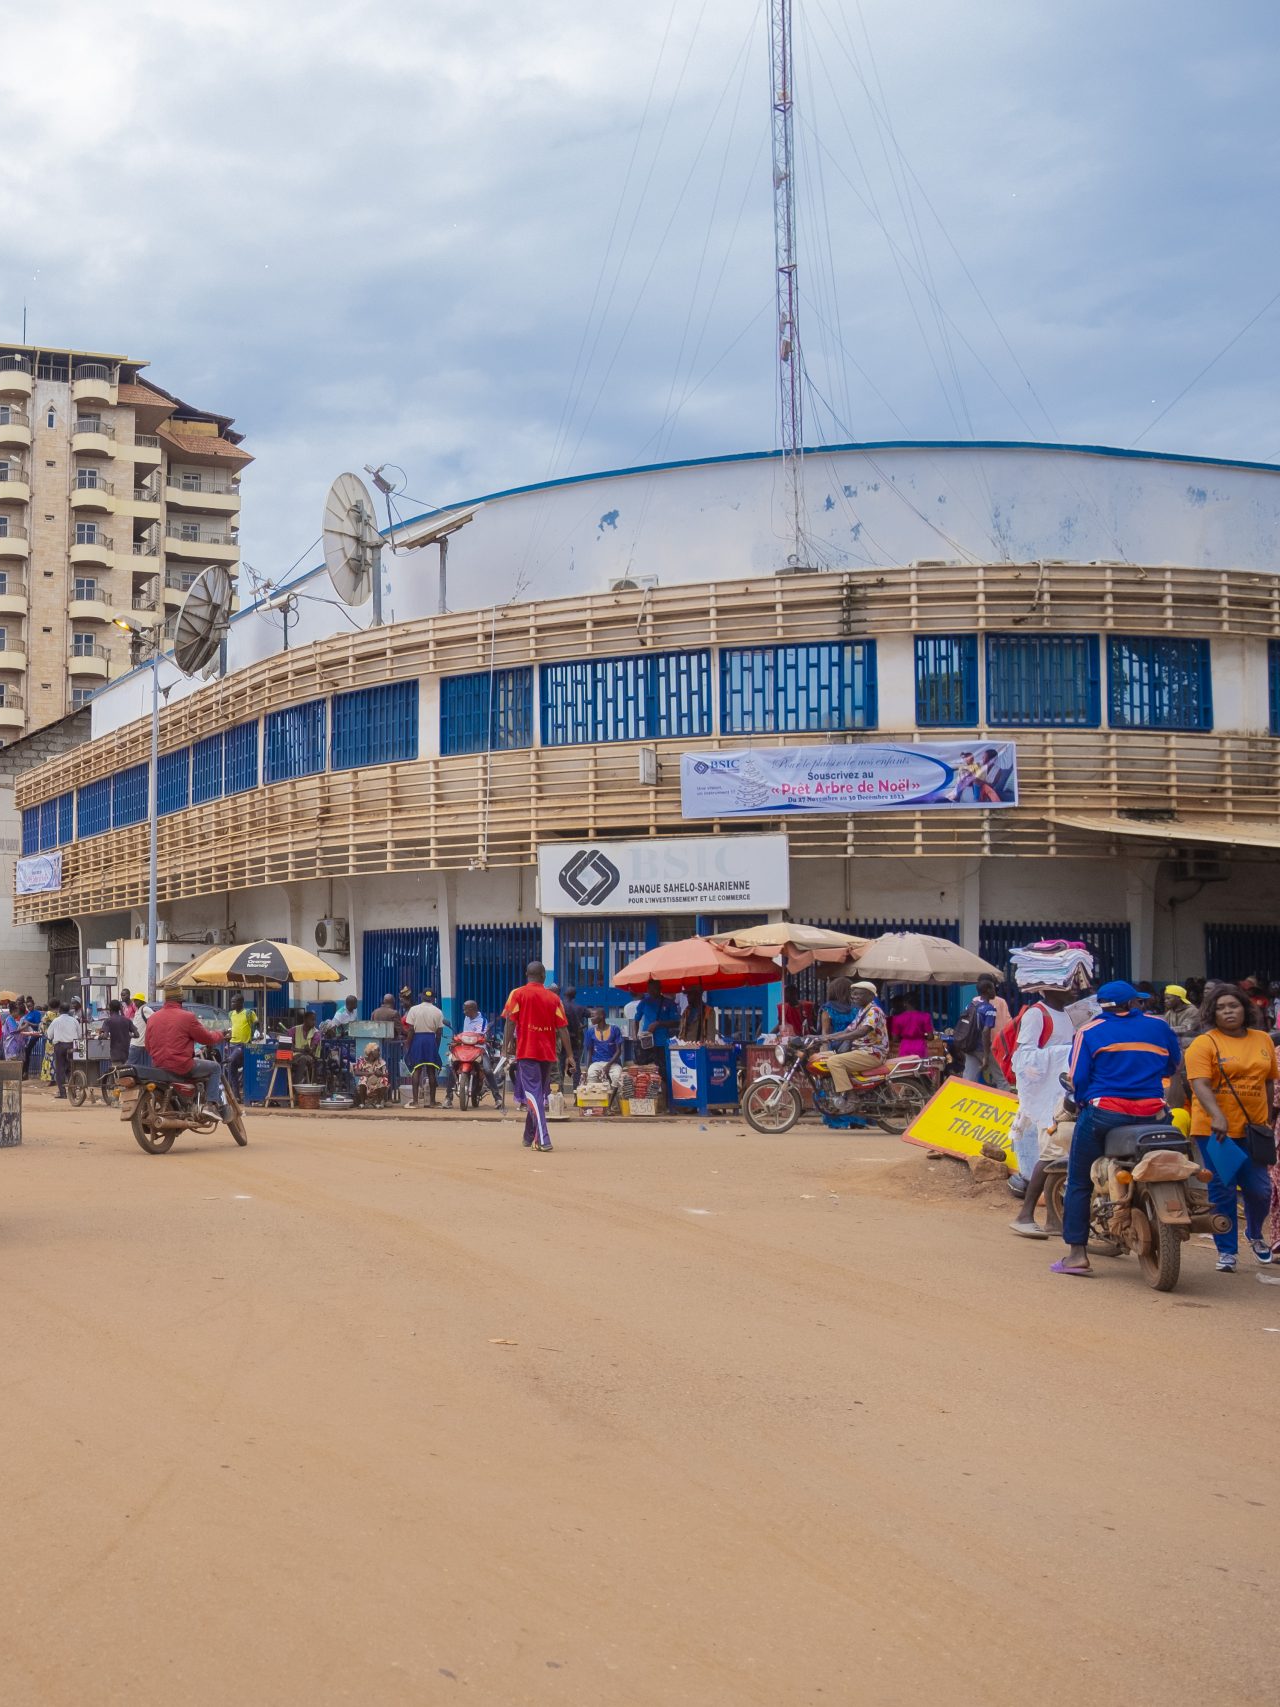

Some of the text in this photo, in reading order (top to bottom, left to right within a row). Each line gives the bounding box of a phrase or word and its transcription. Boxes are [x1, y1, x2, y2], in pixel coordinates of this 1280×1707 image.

[710, 759, 740, 769] BSIC
[807, 770, 874, 781] Souscrivez au
[814, 780, 853, 795] Arbre
[857, 779, 874, 793] de
[628, 880, 750, 894] BANQUE SAHELO-SAHARIENNE
[645, 895, 698, 904] L'INVESTISSEMENT
[717, 893, 751, 902] COMMERCE
[679, 1067, 688, 1075] ICI
